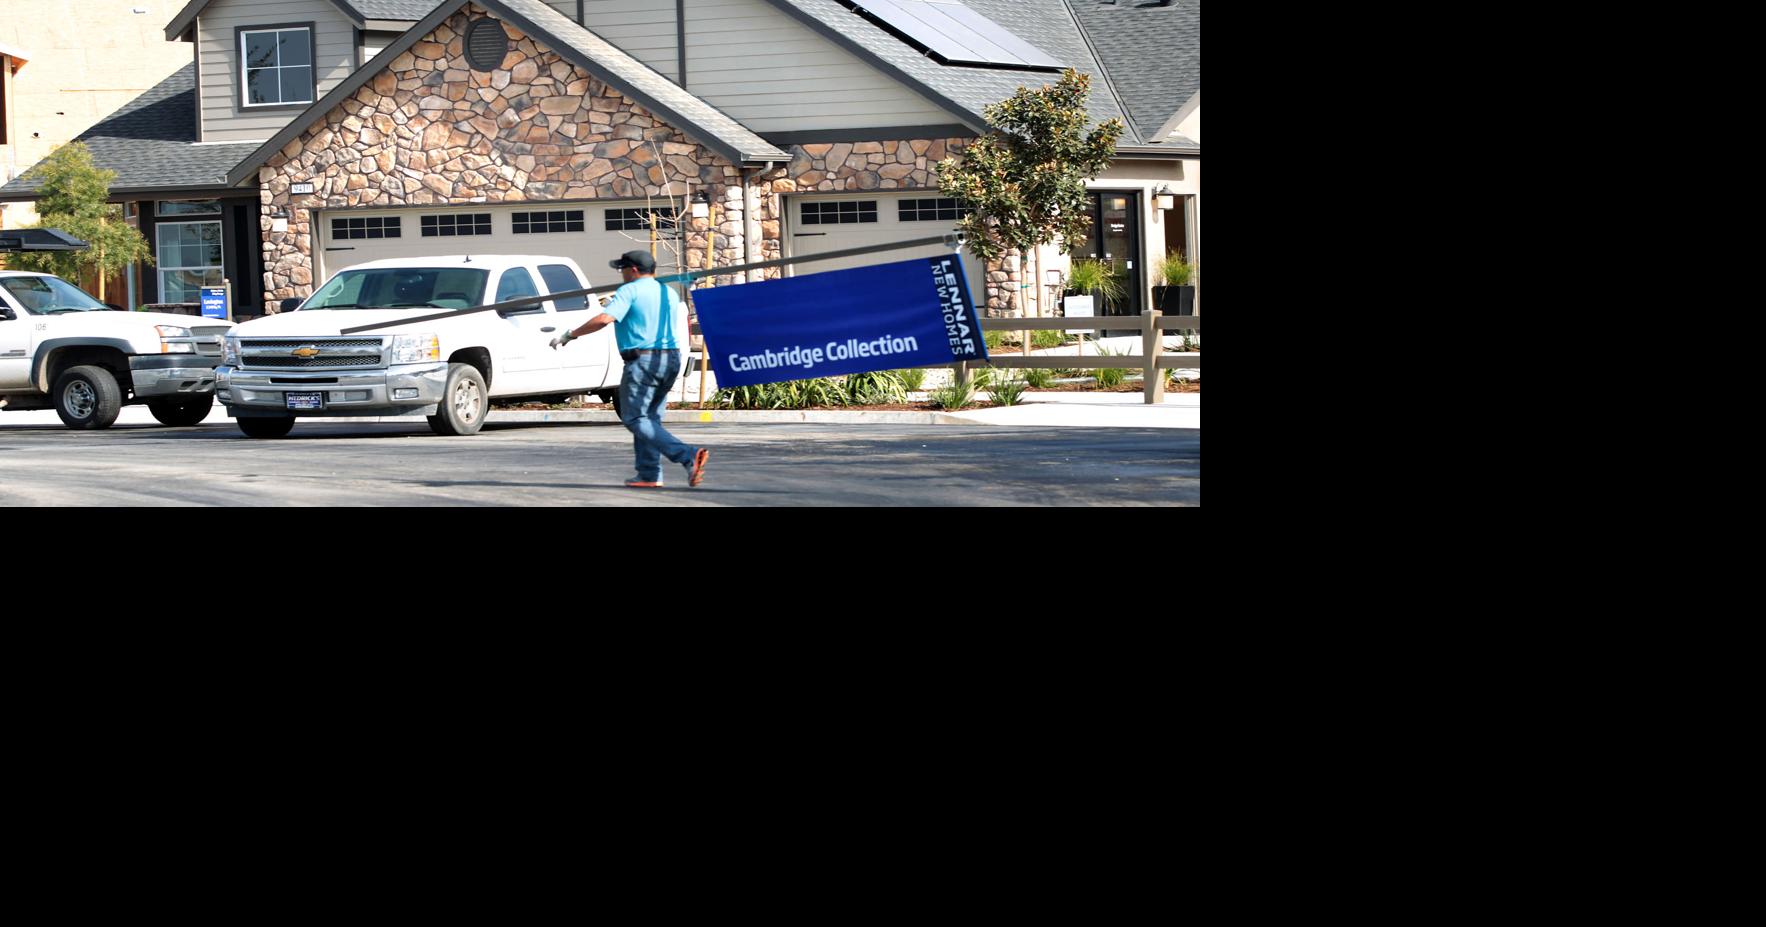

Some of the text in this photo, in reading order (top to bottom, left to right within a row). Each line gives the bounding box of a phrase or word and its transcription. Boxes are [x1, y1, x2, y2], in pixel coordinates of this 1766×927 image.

[931, 265, 963, 355] NEW HOMES
[941, 260, 976, 355] LENNAR
[728, 334, 918, 372] Cambridge Collection
